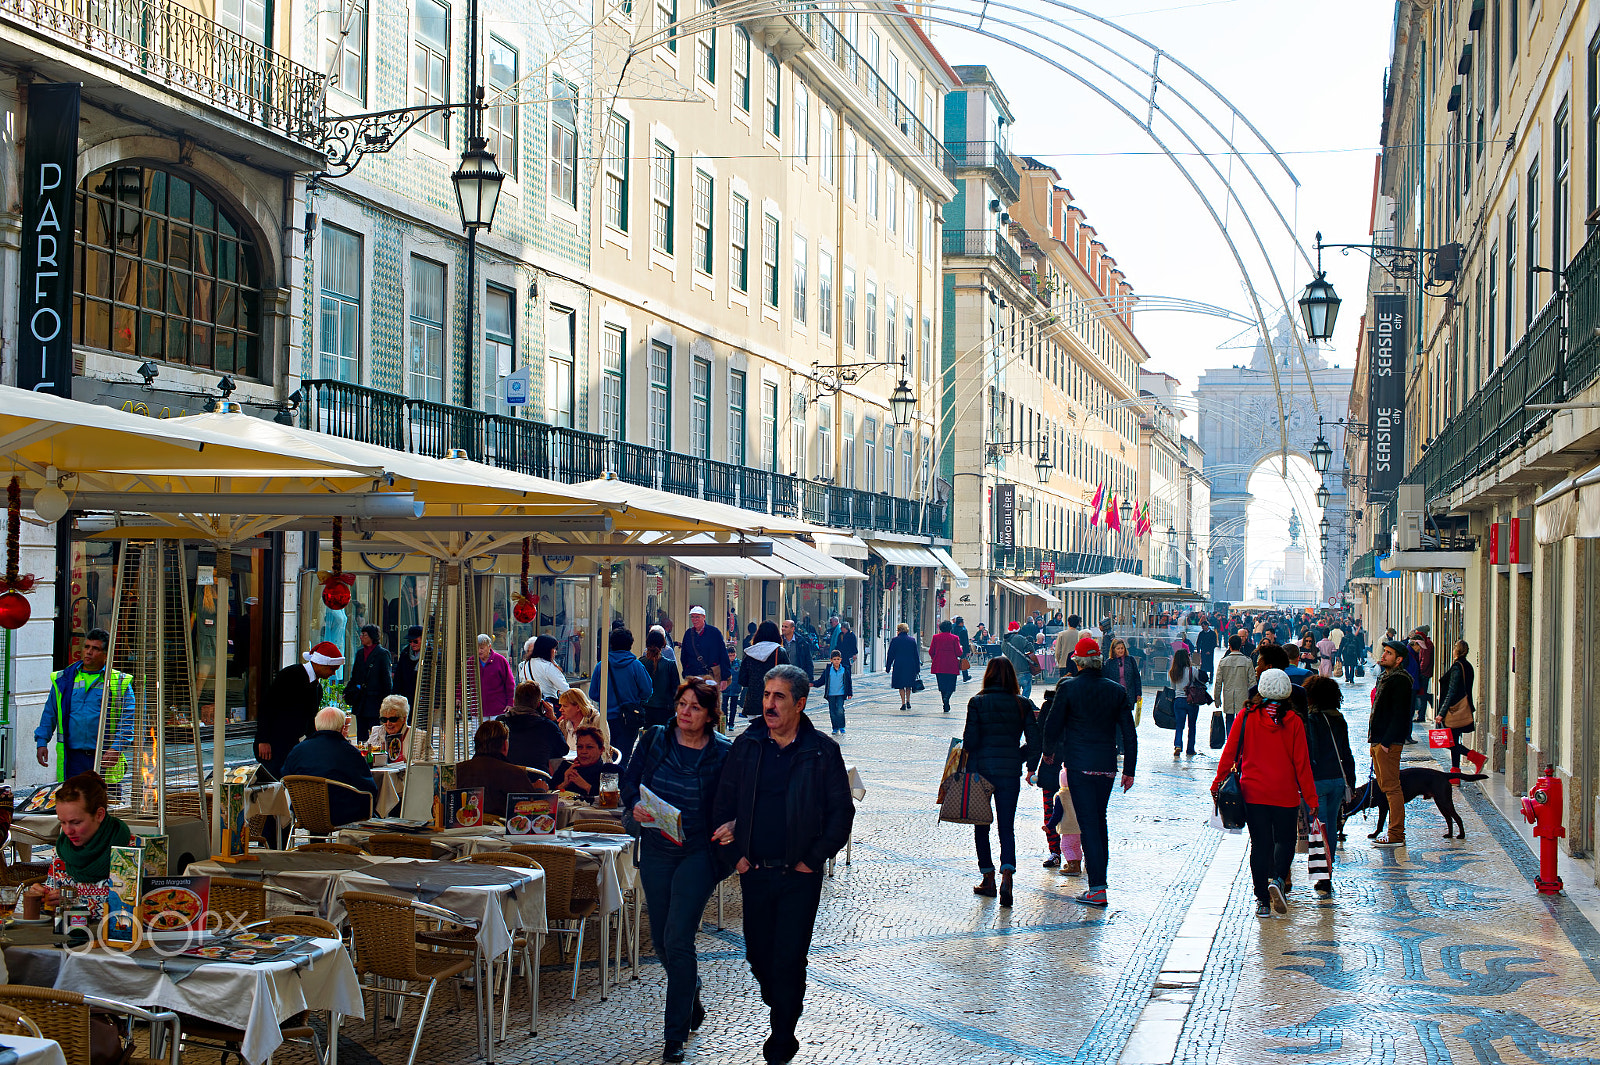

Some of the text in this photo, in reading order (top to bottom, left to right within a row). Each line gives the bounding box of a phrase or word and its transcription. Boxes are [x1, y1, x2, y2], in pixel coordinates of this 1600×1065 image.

[1378, 313, 1392, 377] SEASIDE
[1394, 313, 1403, 330] city
[1377, 408, 1391, 472] SEASIDE
[1393, 408, 1402, 425] city
[1003, 490, 1012, 550] IMMOBILIÈRE
